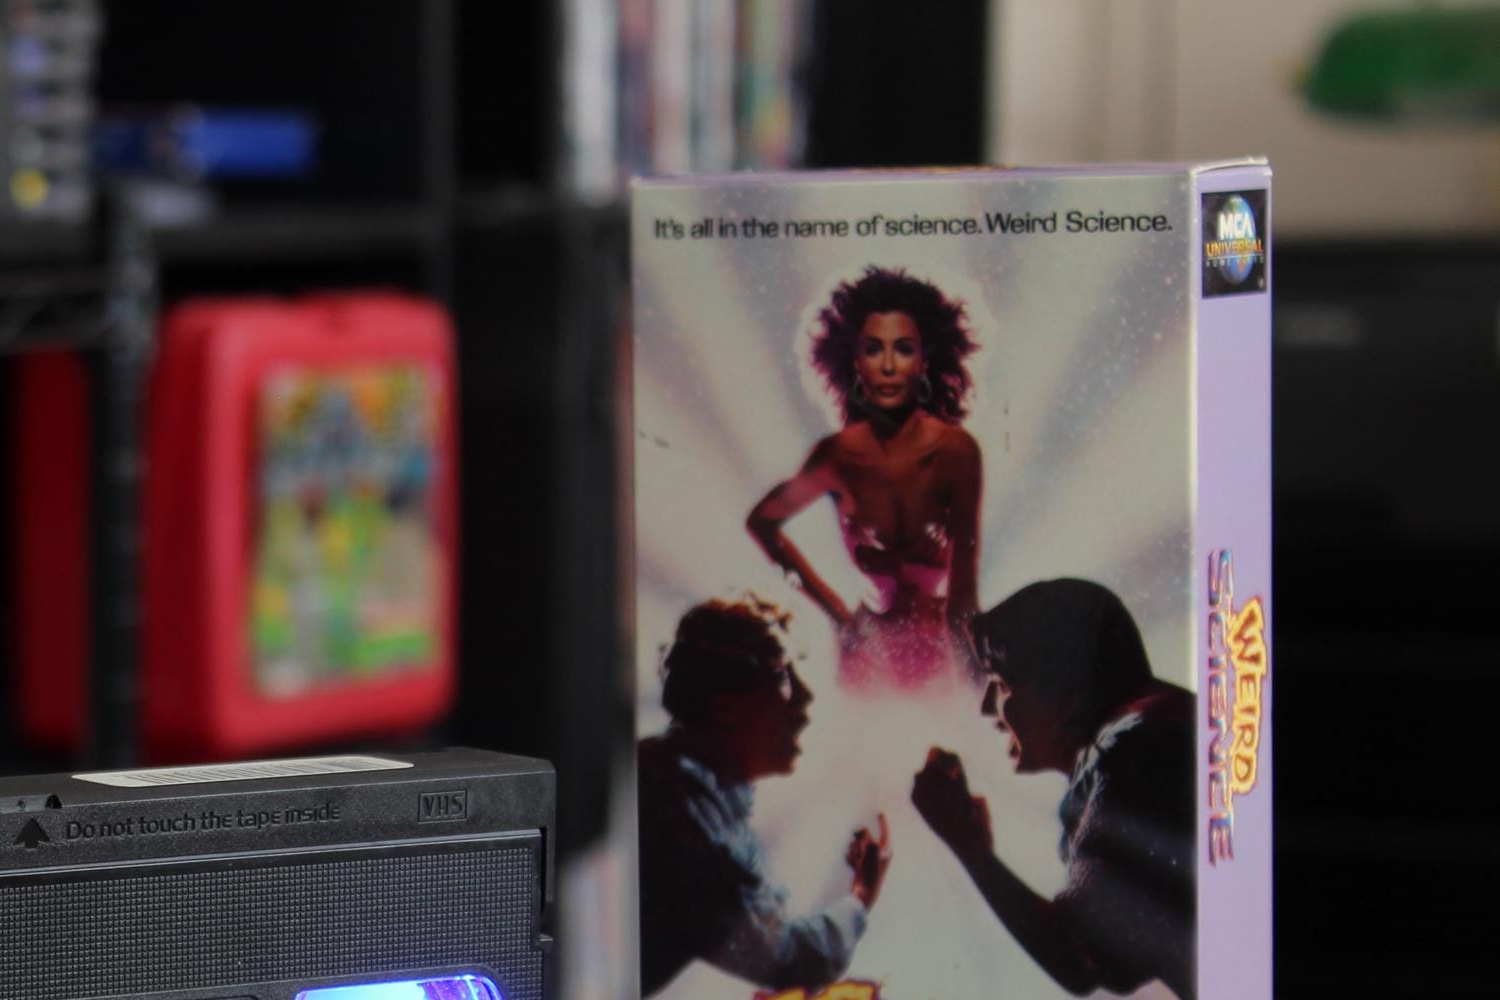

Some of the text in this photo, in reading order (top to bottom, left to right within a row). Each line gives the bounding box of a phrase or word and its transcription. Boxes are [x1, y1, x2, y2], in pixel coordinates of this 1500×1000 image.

[654, 210, 1173, 239] It's all in the name of science. Weird Science.
[1218, 211, 1253, 240] MCA
[1208, 548, 1234, 869] SCIENCE
[1232, 597, 1266, 795] WEIRD
[66, 803, 340, 841] Do not touch the tape inside
[422, 795, 463, 816] VHS
